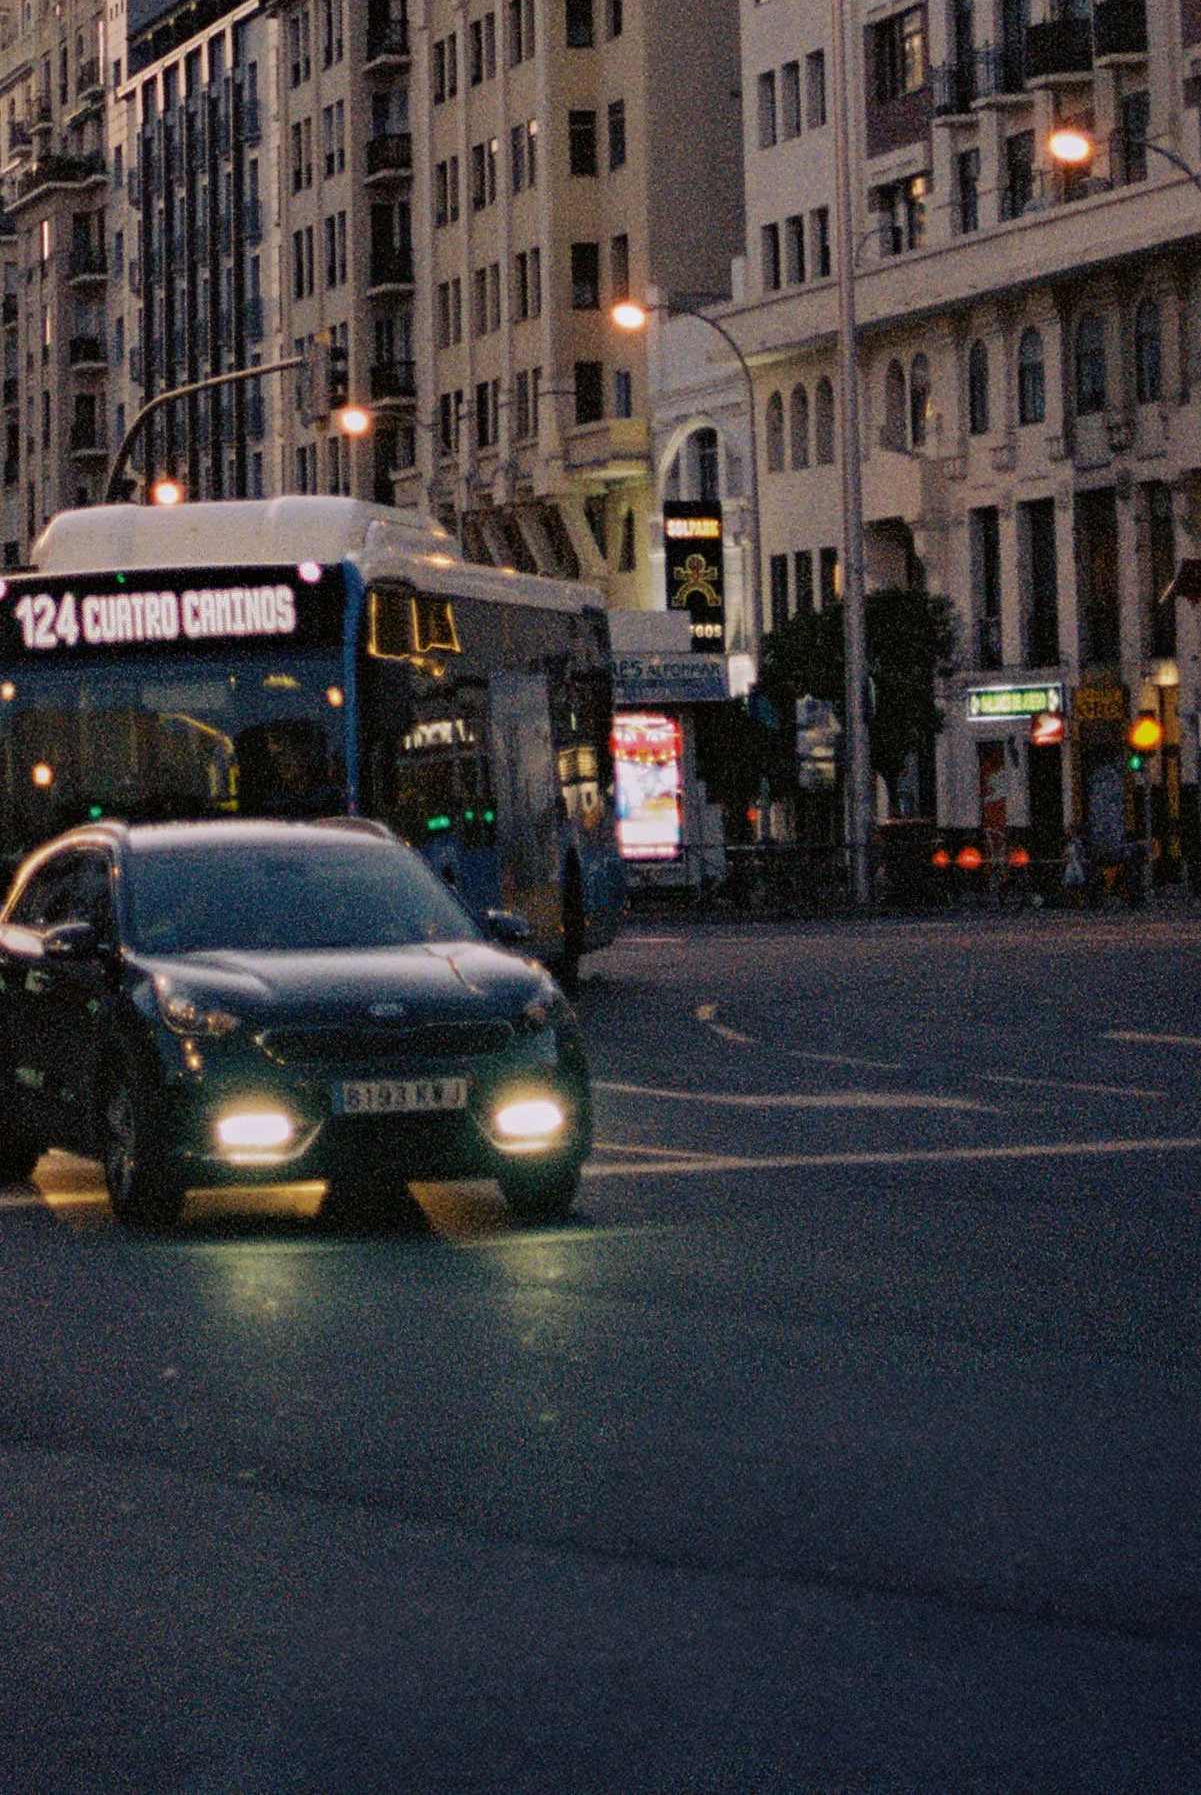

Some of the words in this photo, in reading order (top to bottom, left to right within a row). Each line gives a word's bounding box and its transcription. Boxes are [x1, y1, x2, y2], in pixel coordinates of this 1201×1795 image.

[16, 591, 80, 649] 124
[82, 590, 179, 644] CUATRO
[181, 584, 296, 638] CAMINOS
